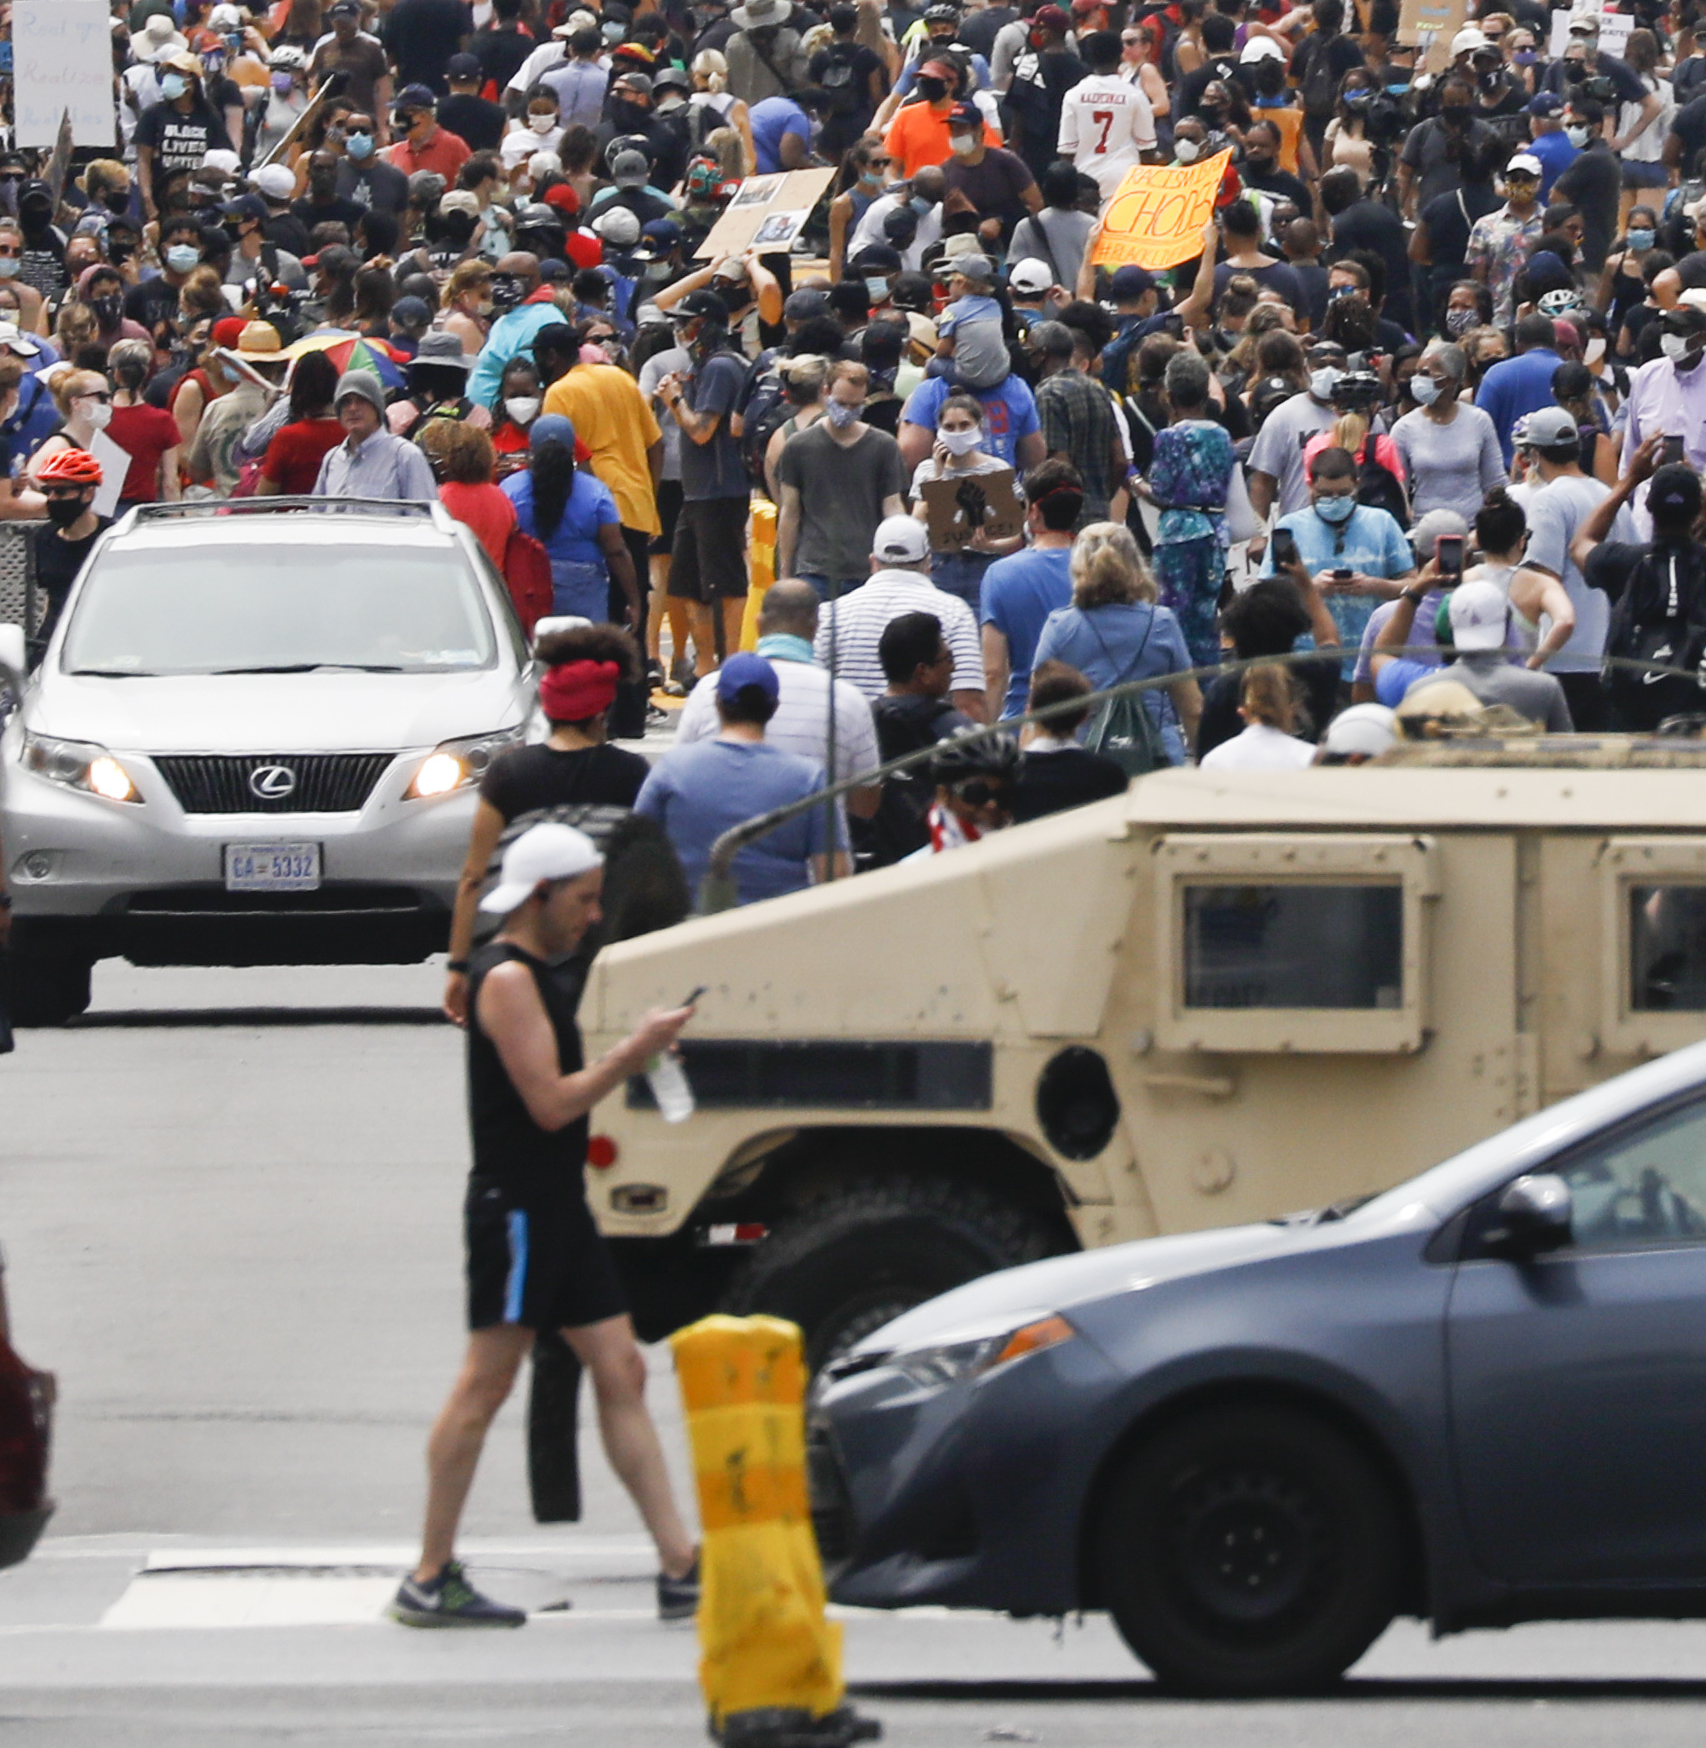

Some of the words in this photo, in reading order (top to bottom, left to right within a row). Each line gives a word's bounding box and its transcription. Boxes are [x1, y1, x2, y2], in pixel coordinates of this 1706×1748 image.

[164, 124, 207, 139] BLACK
[1093, 111, 1113, 154] 7
[162, 139, 207, 153] LIVES
[272, 856, 313, 879] 5332
